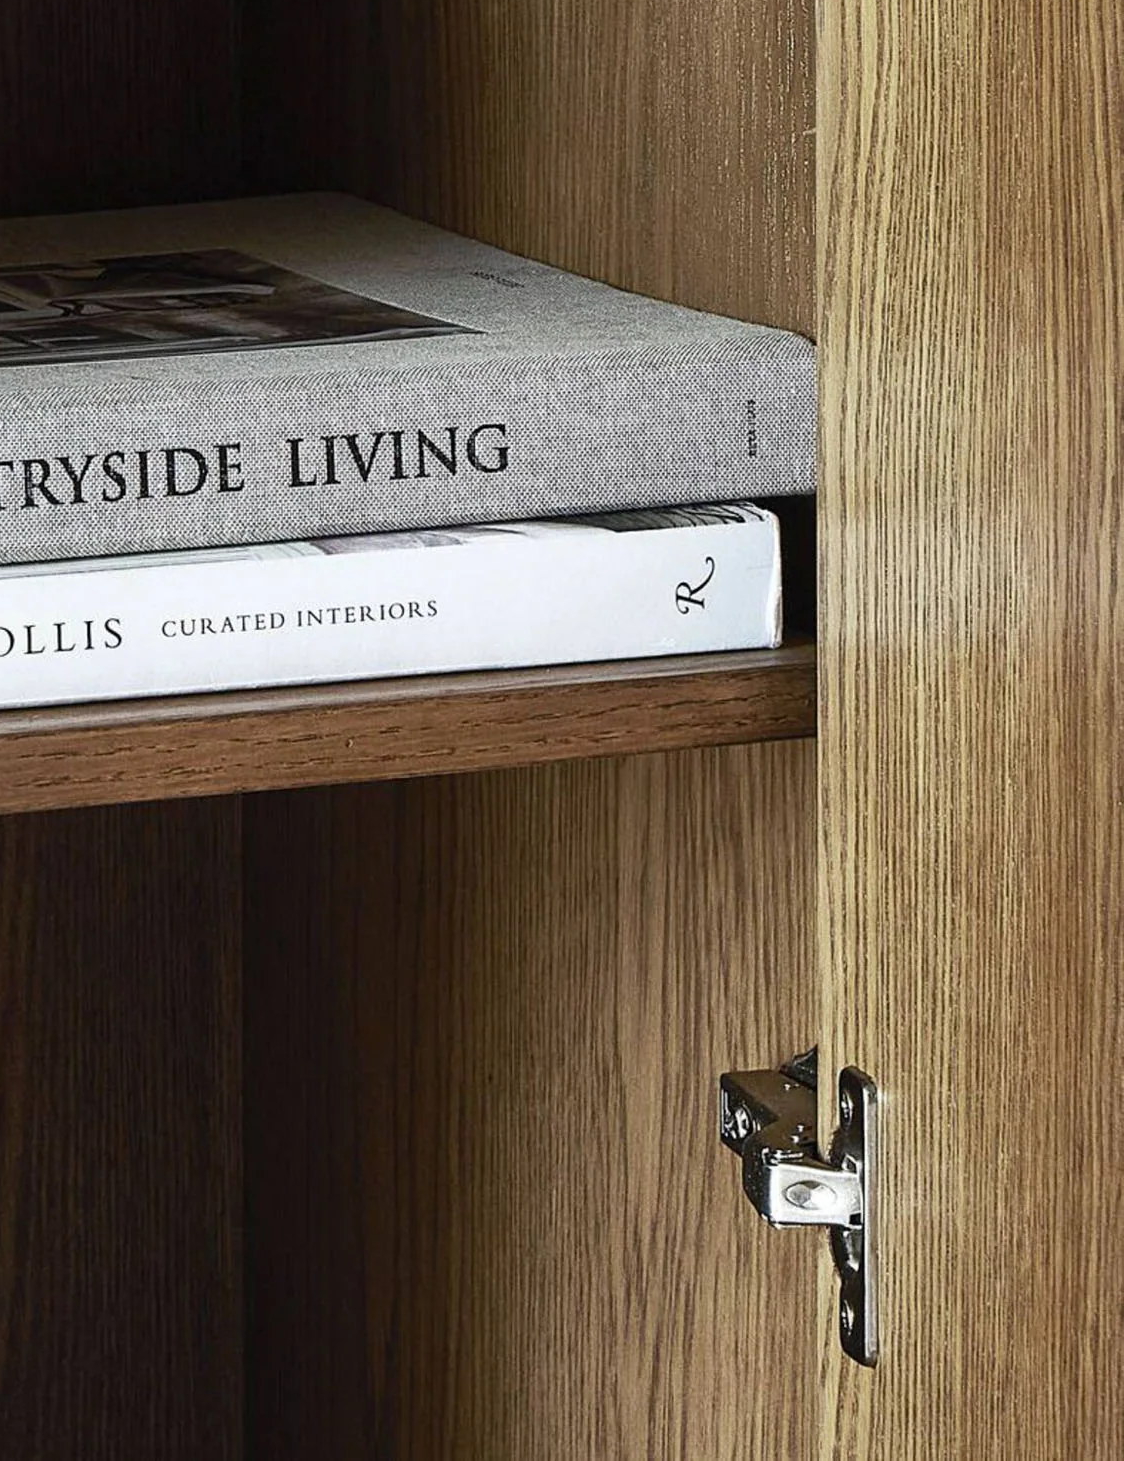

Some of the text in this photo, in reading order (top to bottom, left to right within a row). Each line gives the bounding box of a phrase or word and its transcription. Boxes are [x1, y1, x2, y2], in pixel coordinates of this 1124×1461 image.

[286, 423, 509, 488] LIVING
[675, 556, 716, 615] R
[160, 611, 286, 639] CURATED
[296, 598, 440, 627] INTERIORS
